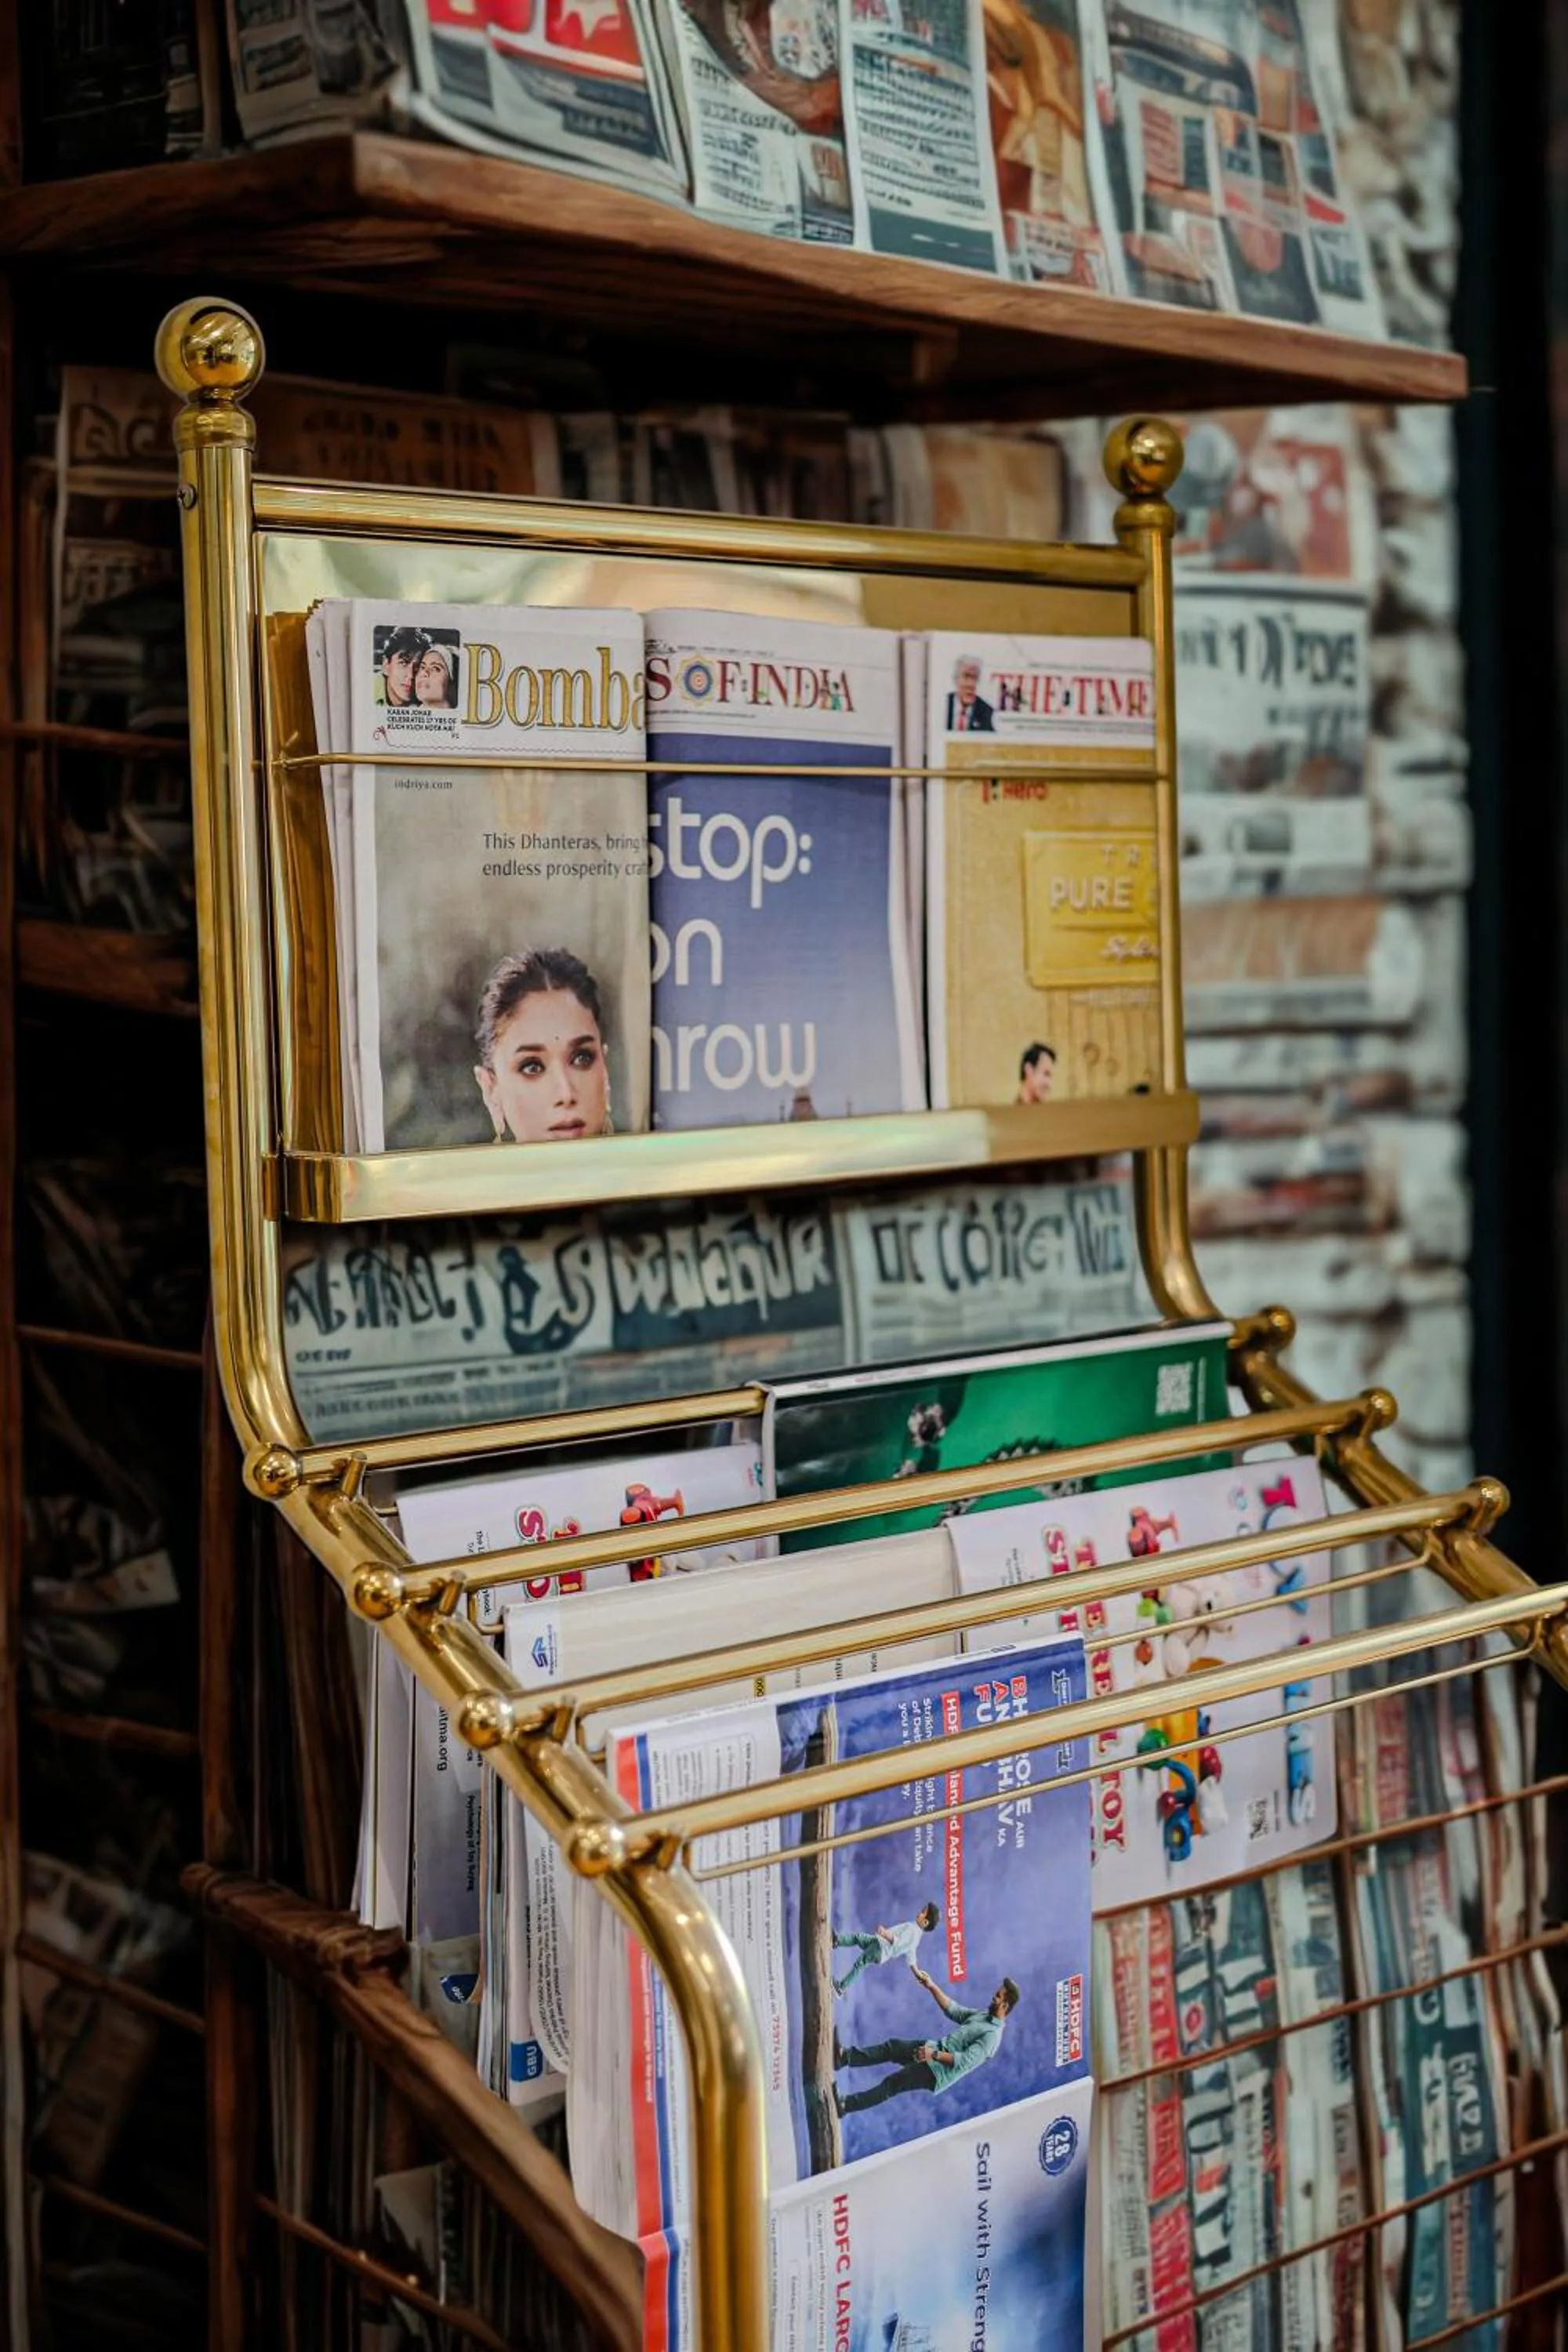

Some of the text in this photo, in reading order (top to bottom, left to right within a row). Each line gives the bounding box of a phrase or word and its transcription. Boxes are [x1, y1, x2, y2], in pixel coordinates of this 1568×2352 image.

[1073, 677, 1156, 718] TIME
[394, 778, 452, 791] indriya.com
[483, 834, 515, 849] This
[521, 834, 601, 851] Dhanteras,
[482, 860, 541, 876] endless
[546, 861, 619, 879] prosperity
[1050, 877, 1135, 911] PURE
[898, 1703, 909, 1726] you
[912, 1700, 923, 1713] of
[923, 1697, 935, 1740] Strikin
[946, 1697, 959, 1734] HDF
[913, 1717, 924, 1742] Deb
[996, 1828, 1007, 1846] KA
[1014, 1820, 1025, 1848] AUR
[914, 1844, 924, 1871] take
[947, 1836, 962, 1926] Advantage
[951, 1930, 964, 1976] Fund
[1069, 1998, 1081, 2054] HDFC
[526, 2045, 538, 2076] GBU
[1044, 2132, 1055, 2164] YEARS
[1054, 2129, 1071, 2158] 28
[975, 2142, 992, 2192] Sail
[832, 2192, 850, 2274] HDFC
[976, 2200, 992, 2259] with
